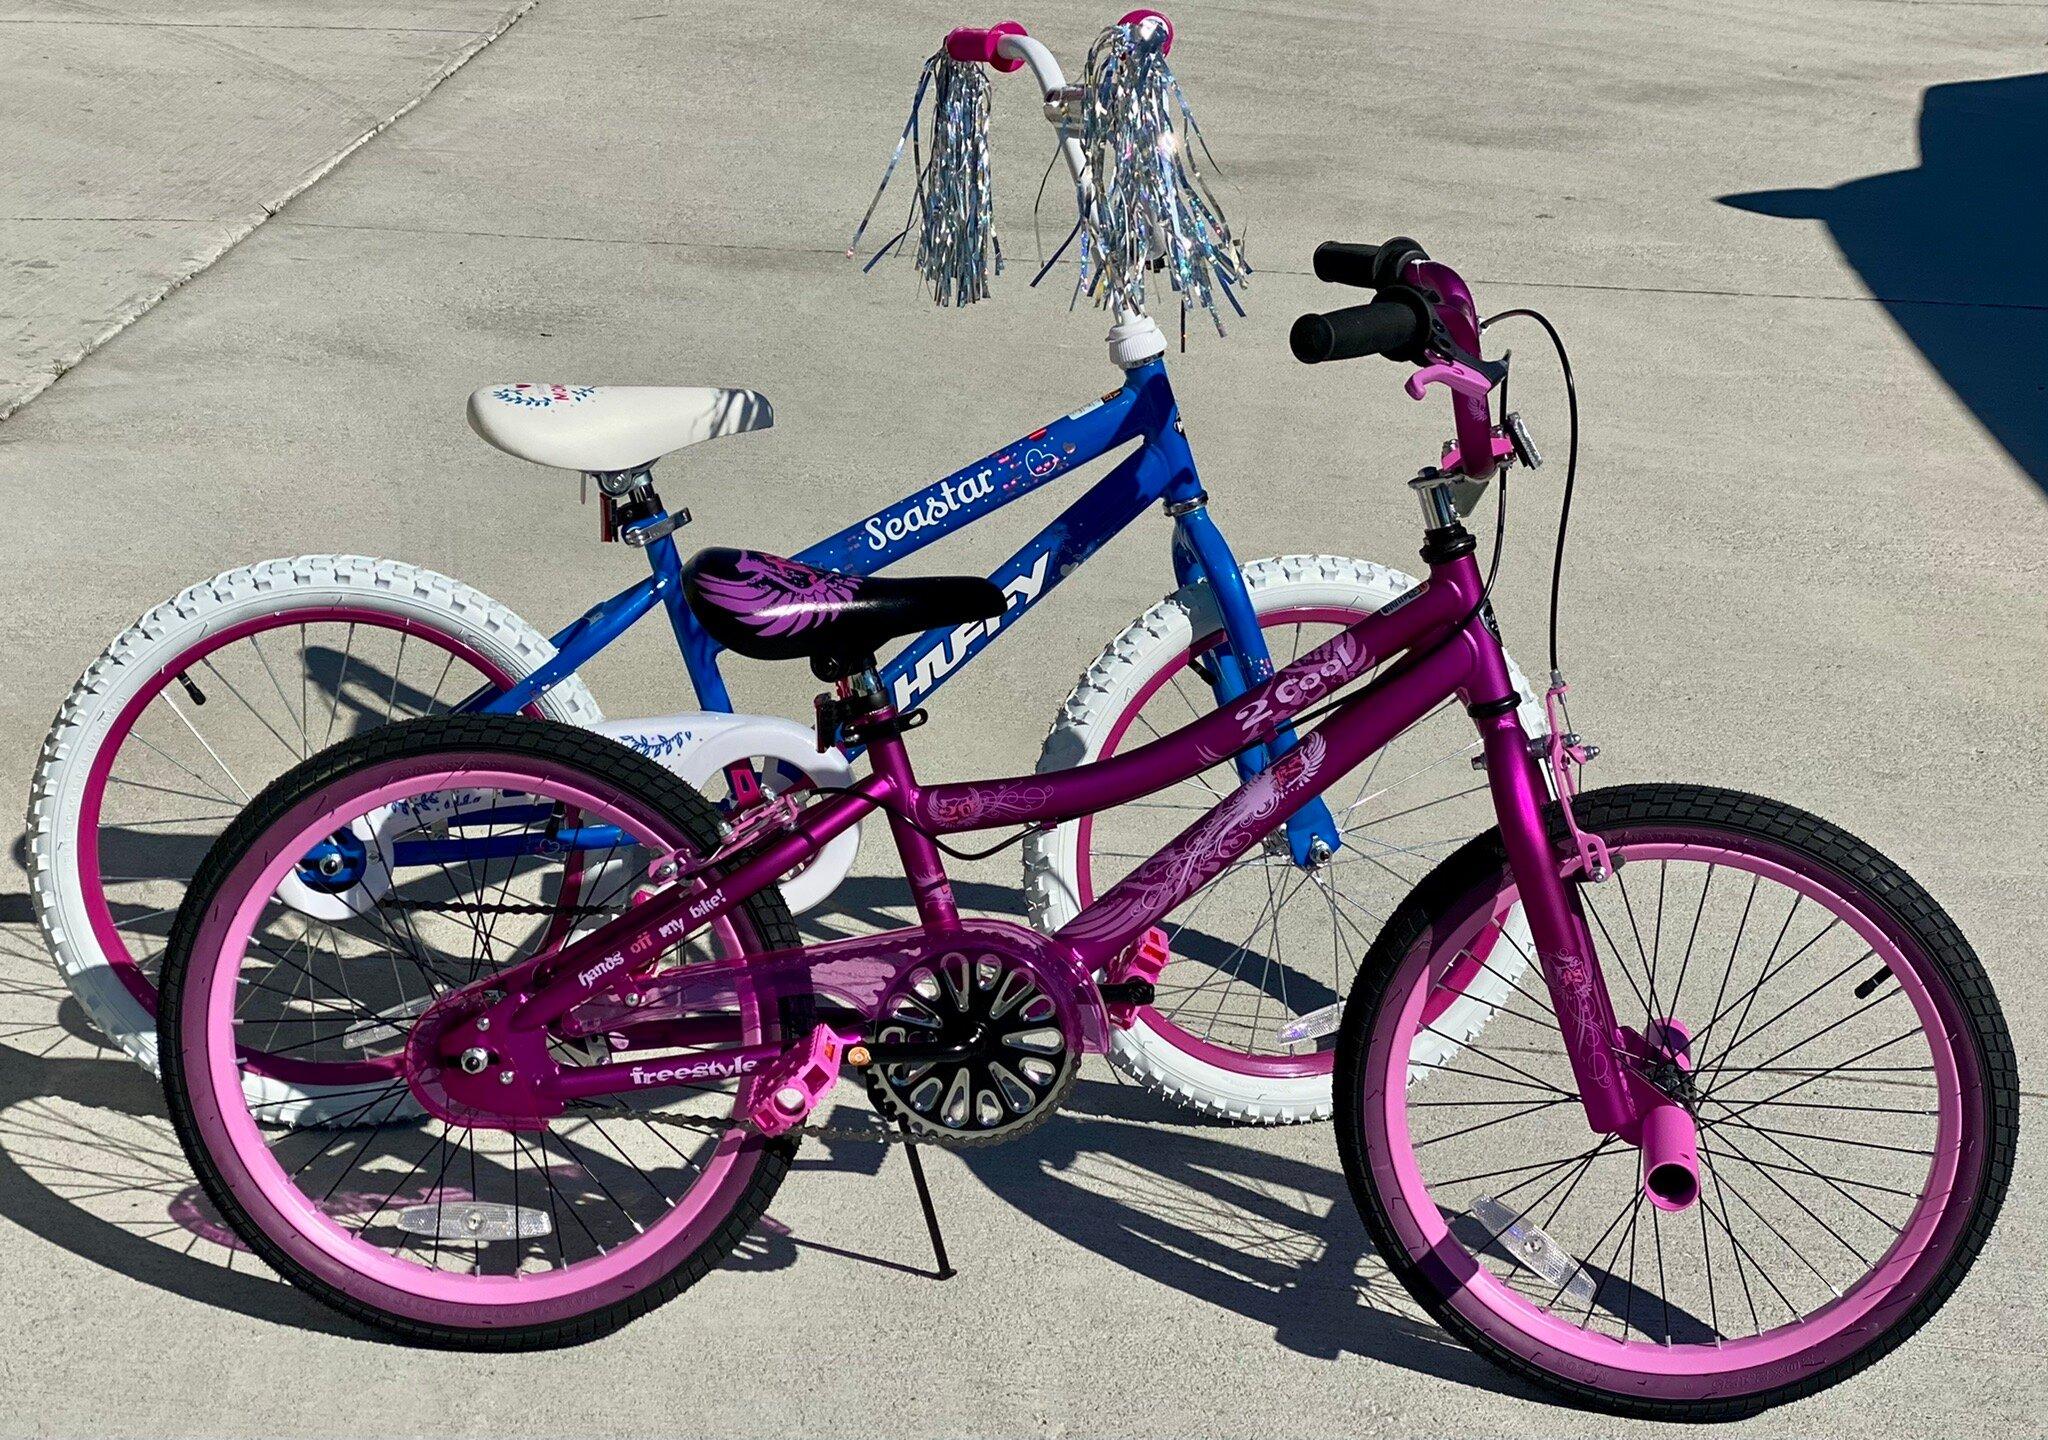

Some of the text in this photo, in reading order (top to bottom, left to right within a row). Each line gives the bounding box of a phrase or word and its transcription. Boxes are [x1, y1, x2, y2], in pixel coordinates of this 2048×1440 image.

[864, 469, 995, 550] Seastar
[1235, 642, 1353, 731] 2 Cool
[577, 951, 625, 989] hands
[658, 917, 684, 939] my
[689, 888, 727, 919] bike!
[630, 1055, 758, 1085] freestyle
